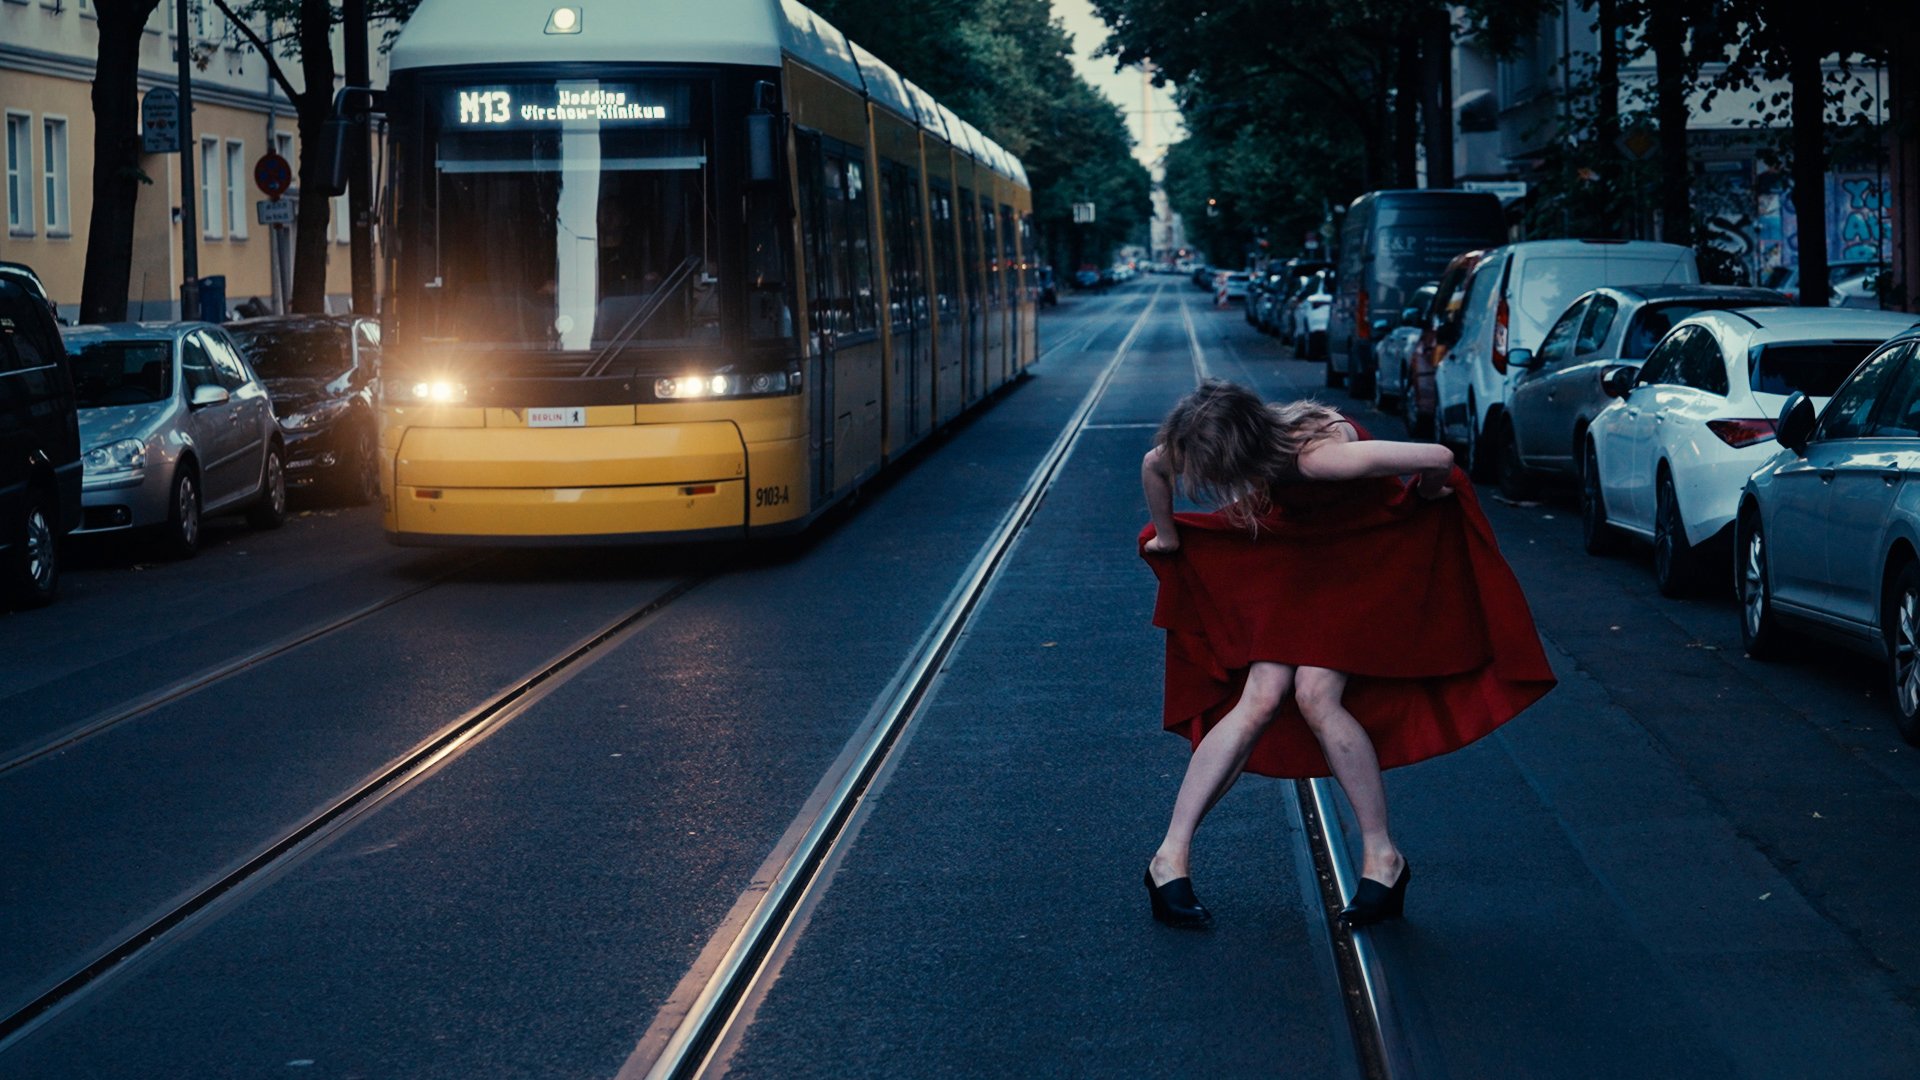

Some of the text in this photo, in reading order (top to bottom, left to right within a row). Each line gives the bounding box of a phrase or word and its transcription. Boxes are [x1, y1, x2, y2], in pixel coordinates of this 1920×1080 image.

[460, 91, 511, 123] M13
[532, 412, 562, 422] BERLIN
[755, 485, 789, 508] 9103-A
